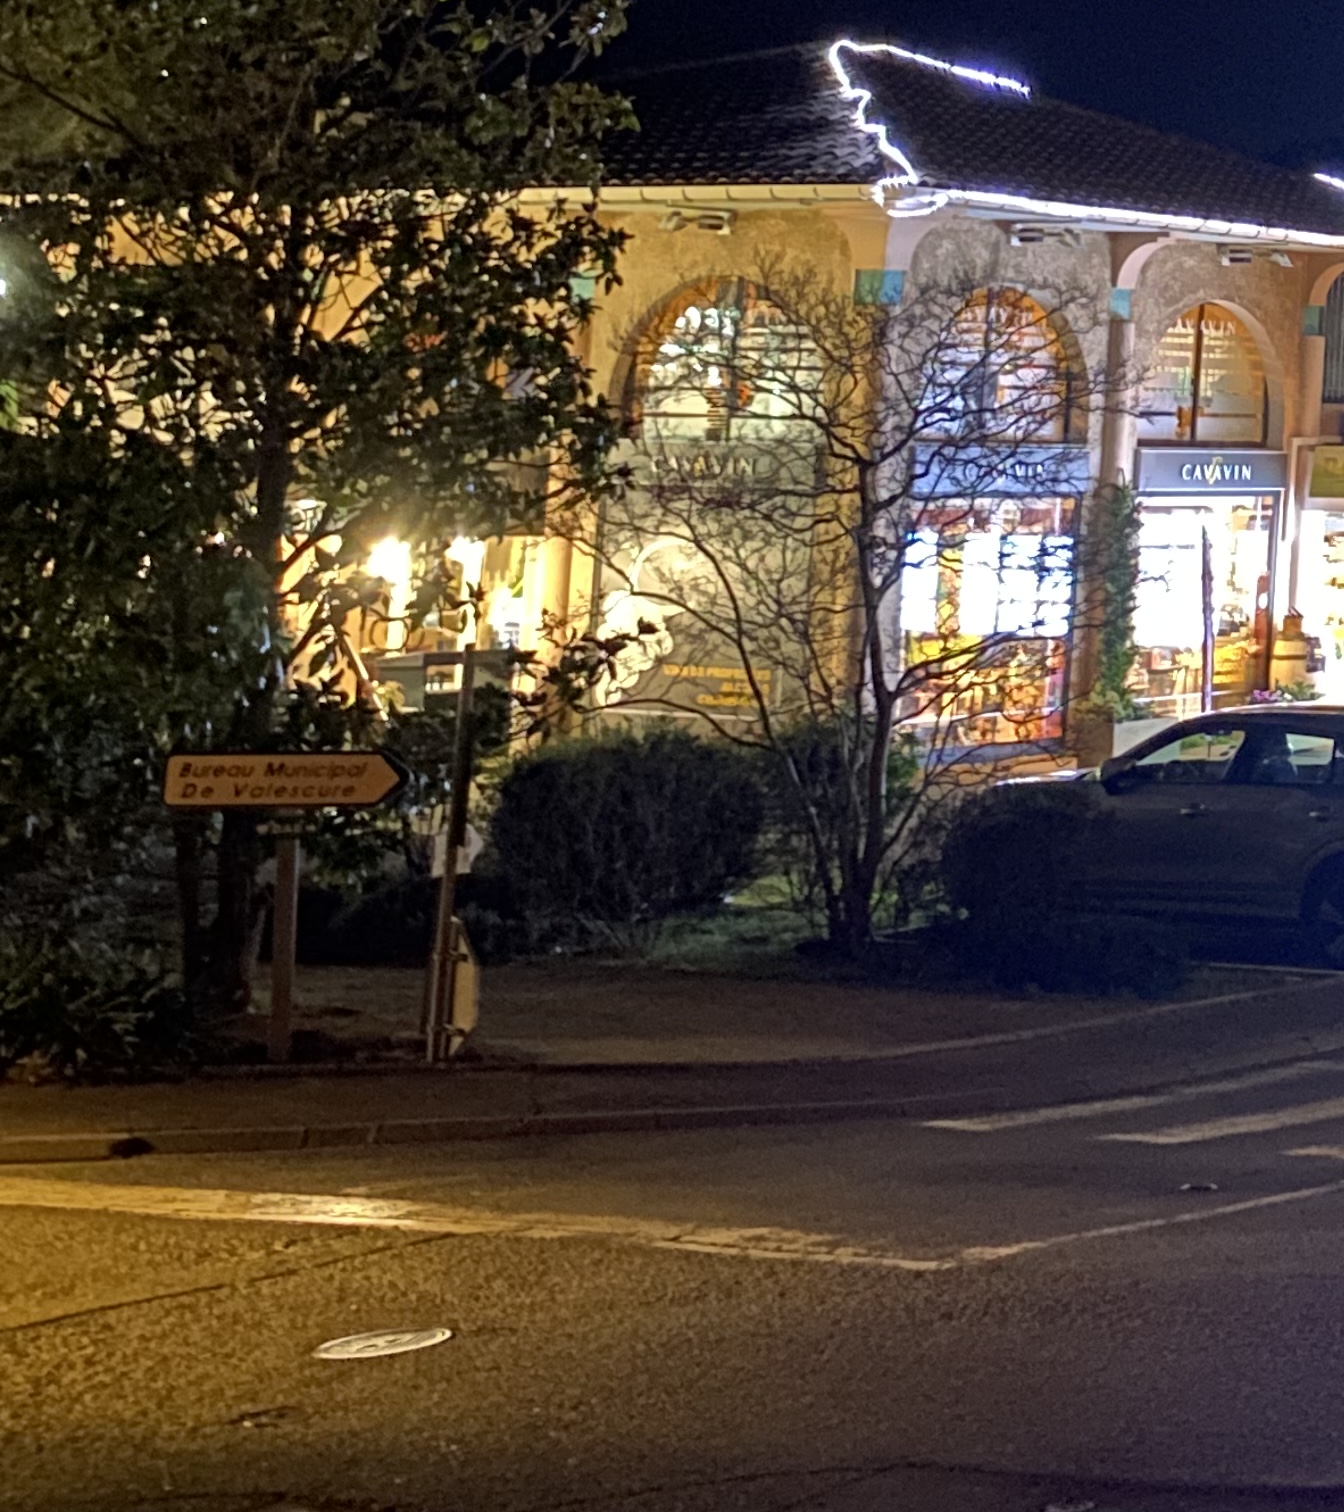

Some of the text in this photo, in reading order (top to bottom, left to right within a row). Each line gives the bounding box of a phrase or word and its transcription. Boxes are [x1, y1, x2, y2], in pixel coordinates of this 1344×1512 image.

[1166, 318, 1237, 336] AVAVIN
[1181, 457, 1252, 484] CAVAVIN
[179, 761, 368, 779] Bureau Municipal
[181, 783, 356, 799] De Valescure
